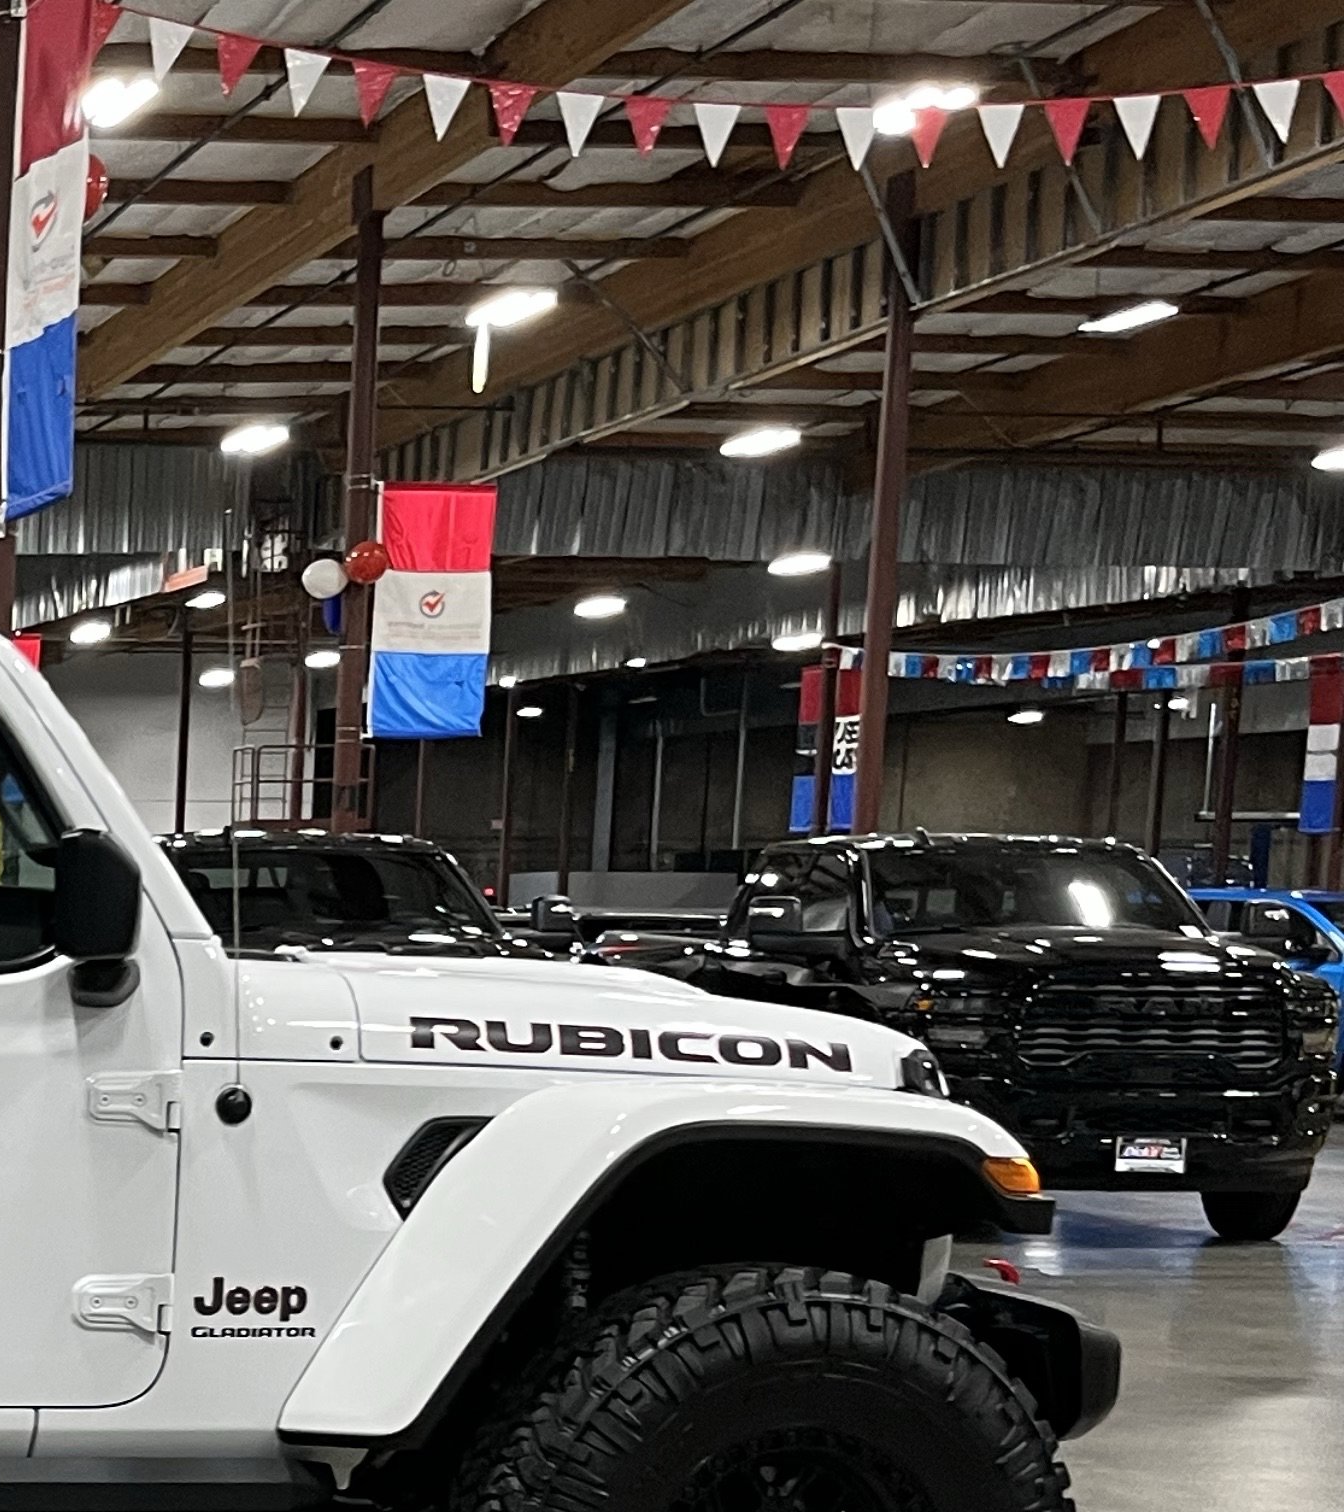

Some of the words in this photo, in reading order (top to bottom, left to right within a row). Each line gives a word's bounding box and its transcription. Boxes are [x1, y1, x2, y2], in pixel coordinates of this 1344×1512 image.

[410, 1015, 853, 1073] RUBICON
[193, 1276, 308, 1323] Jeep
[191, 1326, 316, 1338] GLADIATOR
